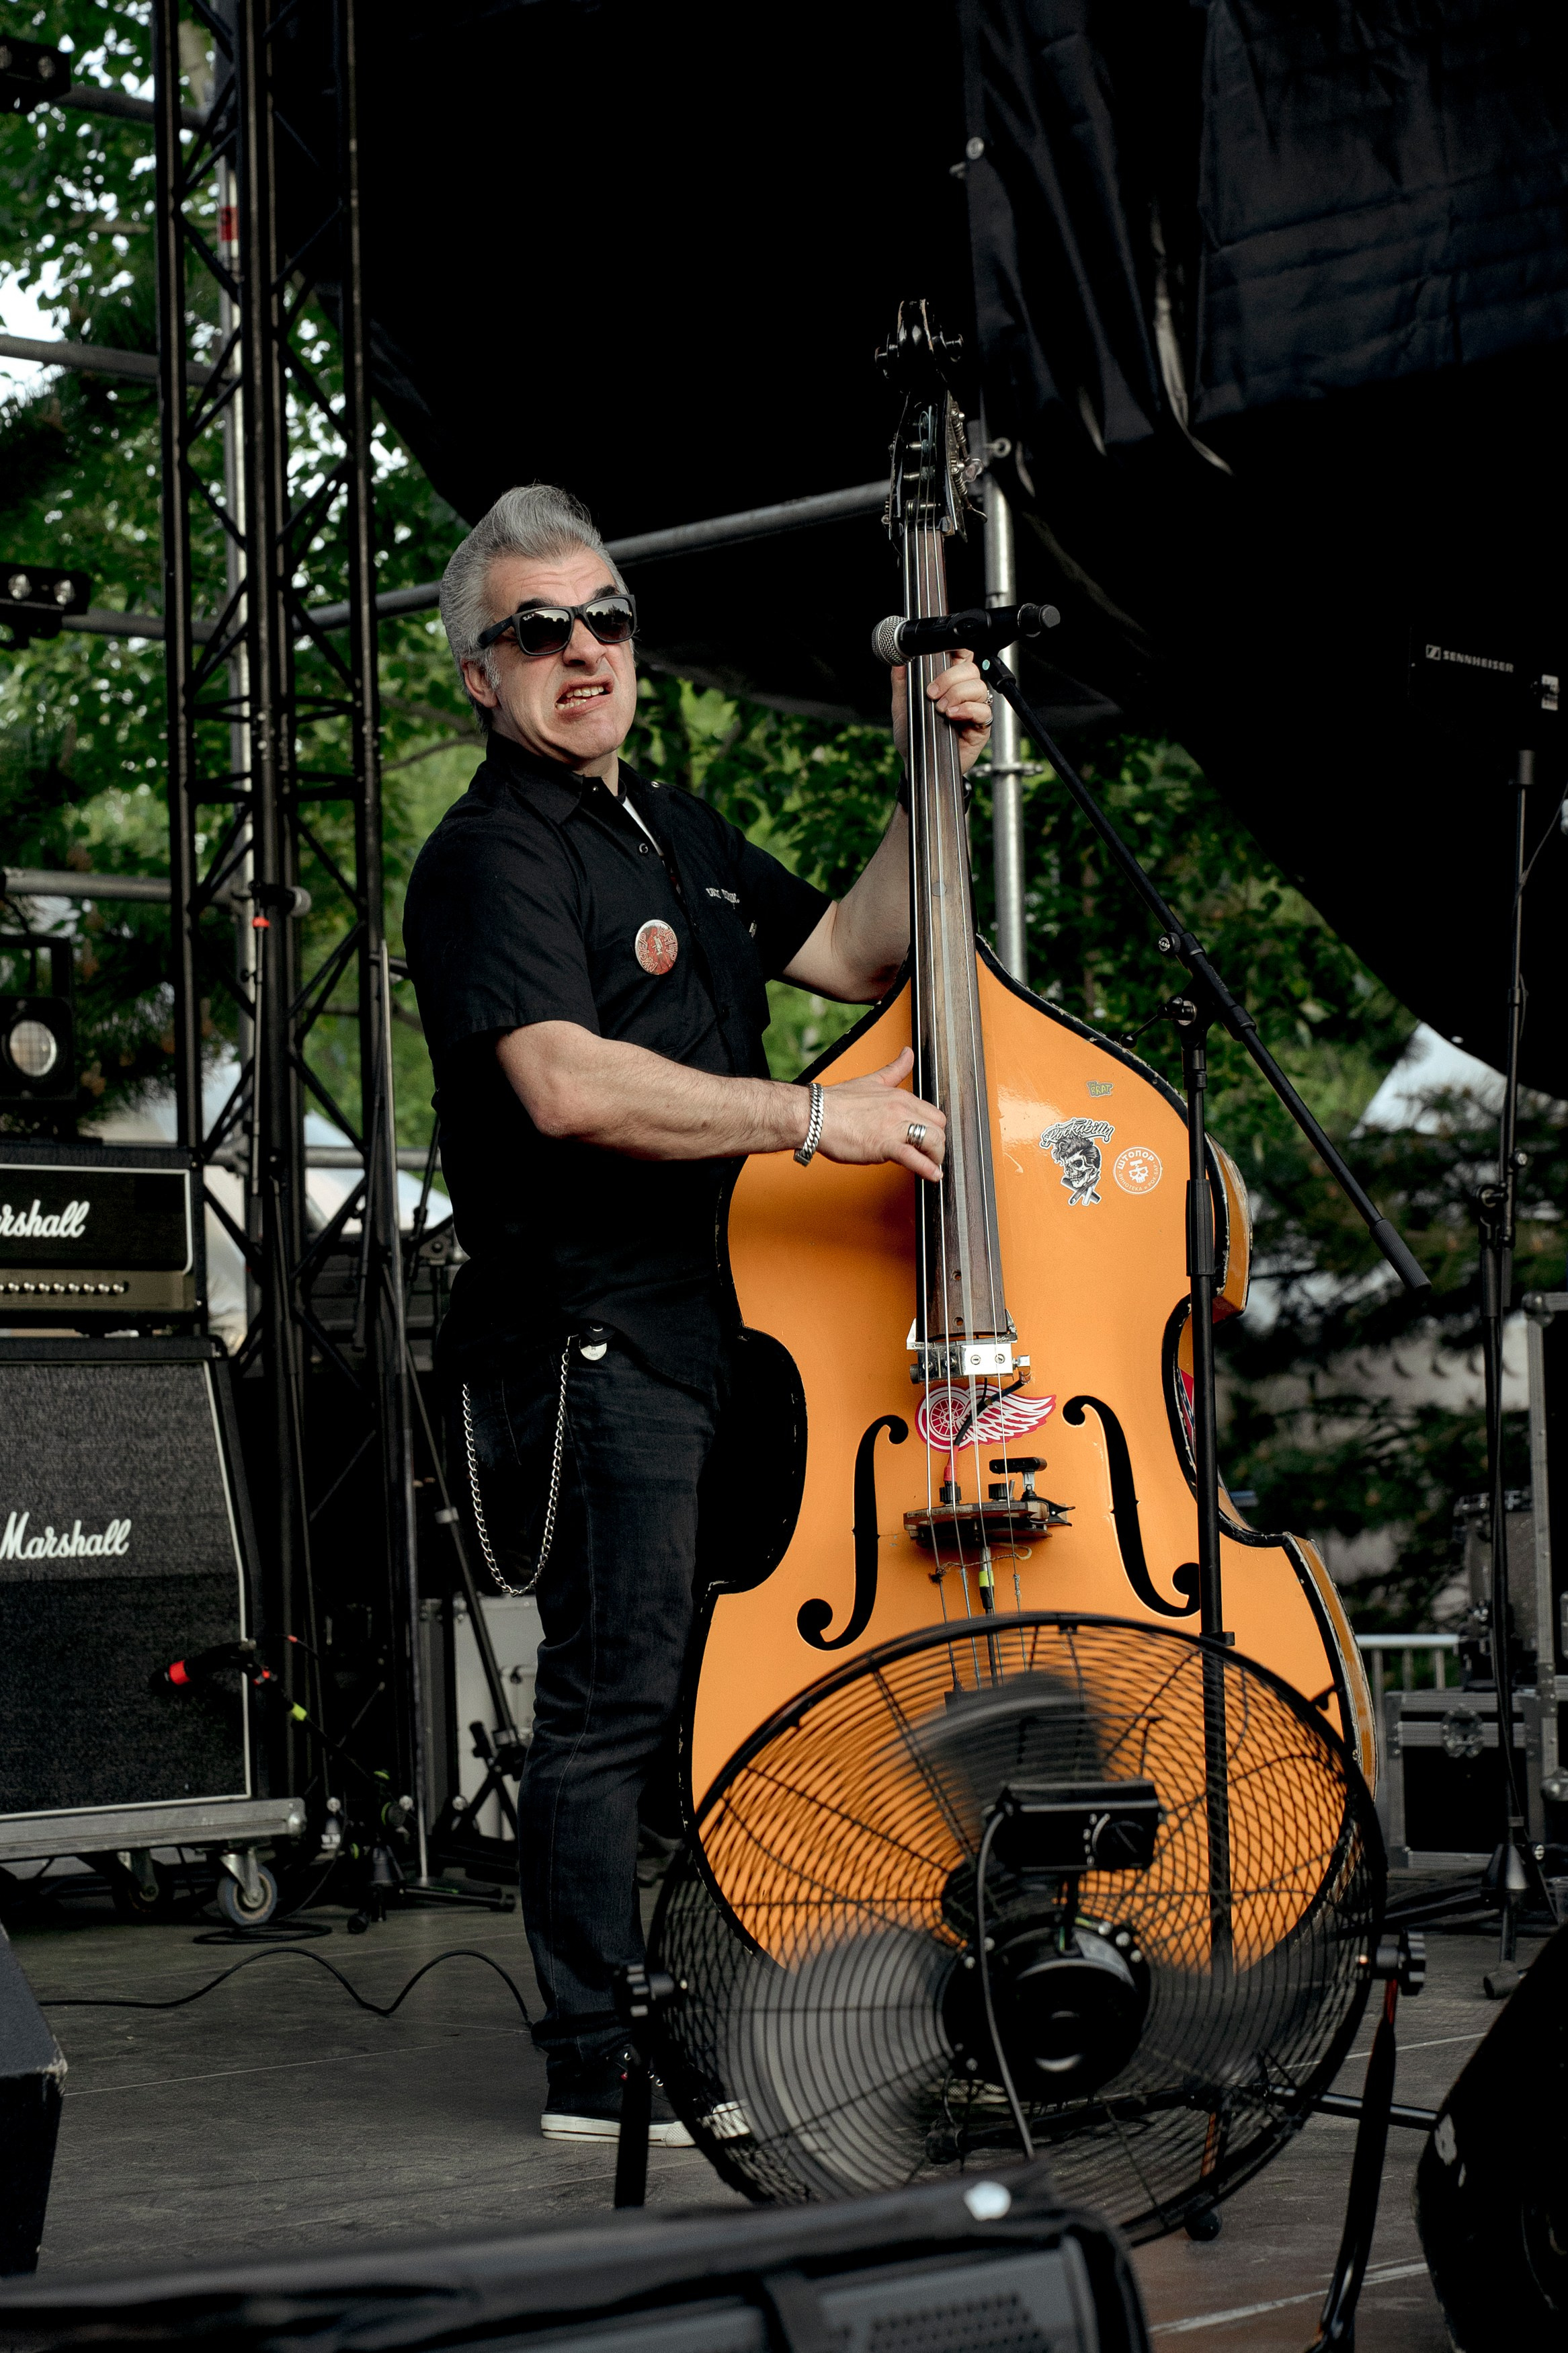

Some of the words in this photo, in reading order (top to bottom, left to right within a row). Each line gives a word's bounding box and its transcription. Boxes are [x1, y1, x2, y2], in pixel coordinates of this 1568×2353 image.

[1443, 649, 1514, 673] SENNHEISER
[1040, 1119, 1114, 1148] Rockabilly
[1117, 1150, 1155, 1170] ШТОПОР
[1118, 1172, 1143, 1191] ВИНОТЕКА
[0, 1511, 132, 1560] Marshall
